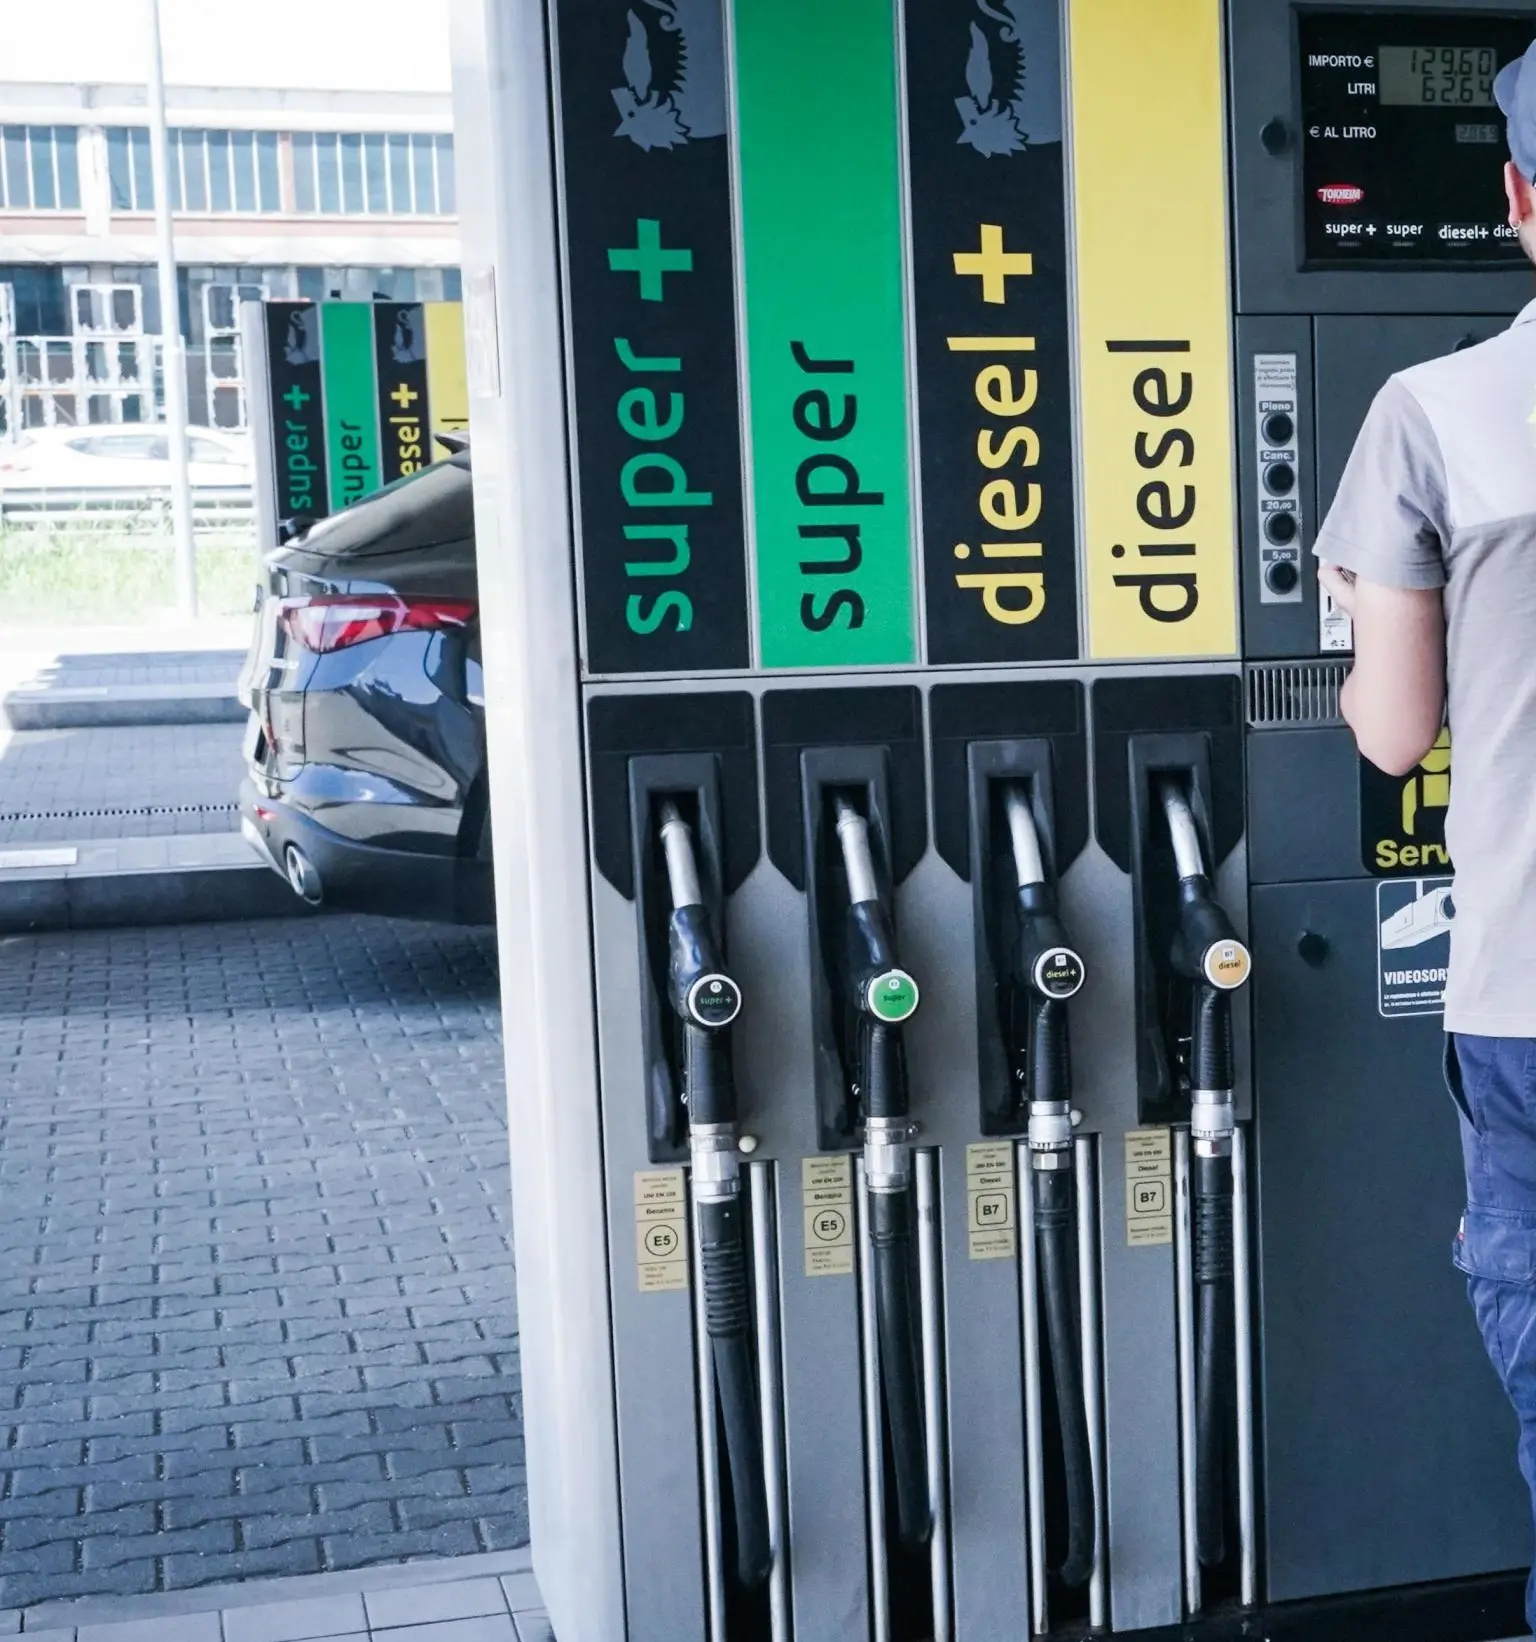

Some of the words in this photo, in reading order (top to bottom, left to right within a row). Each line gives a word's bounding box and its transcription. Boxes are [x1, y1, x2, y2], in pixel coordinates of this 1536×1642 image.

[1308, 55, 1362, 68] IMPORTO
[1363, 56, 1375, 68] €
[1347, 83, 1376, 95] LITRI
[1309, 126, 1320, 138] €
[1324, 127, 1339, 138] AL
[1343, 127, 1377, 138] LITRO
[1325, 223, 1363, 236] super
[1386, 223, 1423, 237] super
[1492, 224, 1519, 238] dies
[1261, 402, 1291, 411] Pieno
[388, 416, 422, 477] esel
[285, 419, 317, 509] super
[613, 337, 713, 637] super
[789, 339, 885, 633] super
[945, 336, 1046, 626] diesel
[1104, 339, 1199, 623] diesel
[1375, 839, 1450, 868] Serv
[1219, 960, 1241, 970] diesel
[1046, 969, 1069, 978] diesel
[1384, 968, 1448, 985] VIDEOSOR
[1140, 1192, 1157, 1203] B7
[983, 1204, 999, 1215] B7
[821, 1220, 838, 1231] E5
[654, 1235, 671, 1246] E5
